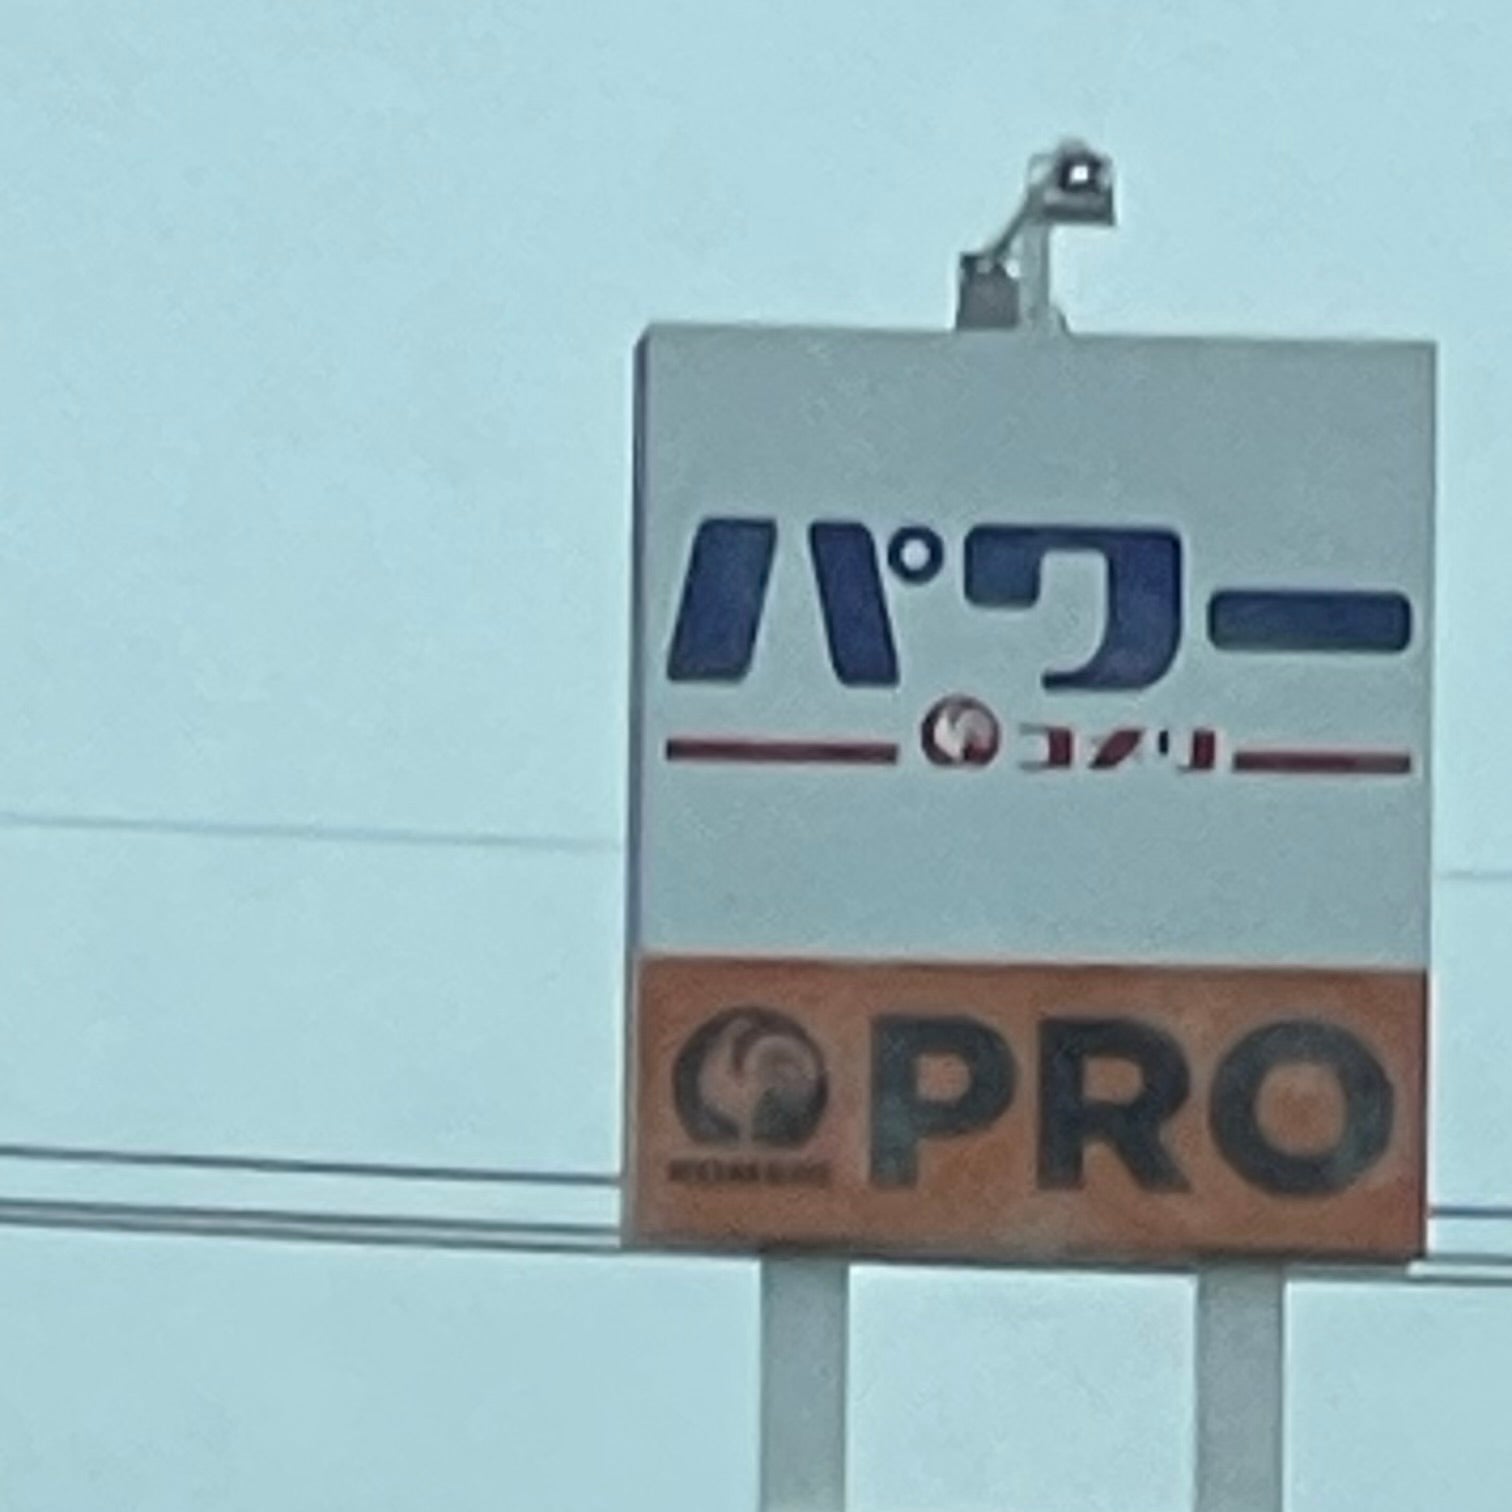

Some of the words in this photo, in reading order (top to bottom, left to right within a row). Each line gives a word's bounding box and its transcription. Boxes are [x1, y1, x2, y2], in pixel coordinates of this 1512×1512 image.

[666, 518, 1412, 693] パワー
[1018, 722, 1216, 772] コメリ
[867, 1012, 1396, 1200] PRO
